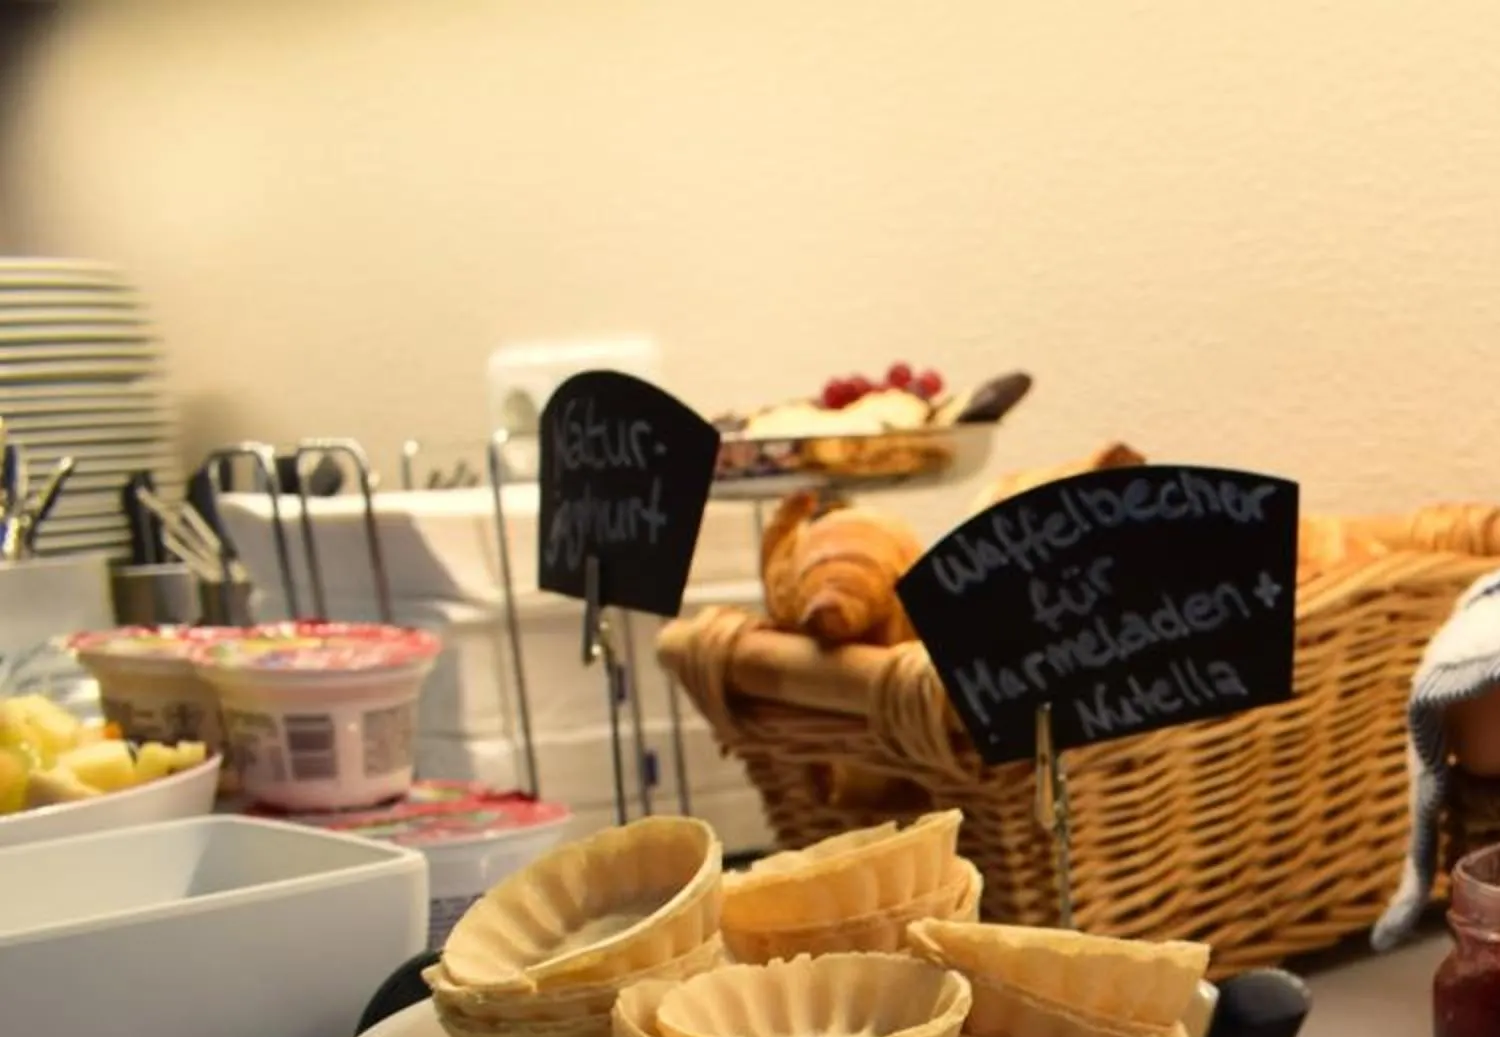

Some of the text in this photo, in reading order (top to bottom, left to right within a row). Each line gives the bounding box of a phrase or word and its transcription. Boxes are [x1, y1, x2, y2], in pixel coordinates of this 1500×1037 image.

[932, 471, 1277, 595] Waffelbecher
[1028, 556, 1115, 632] für
[953, 583, 1251, 726] Marmeladen
[1073, 657, 1248, 739] Nutella
